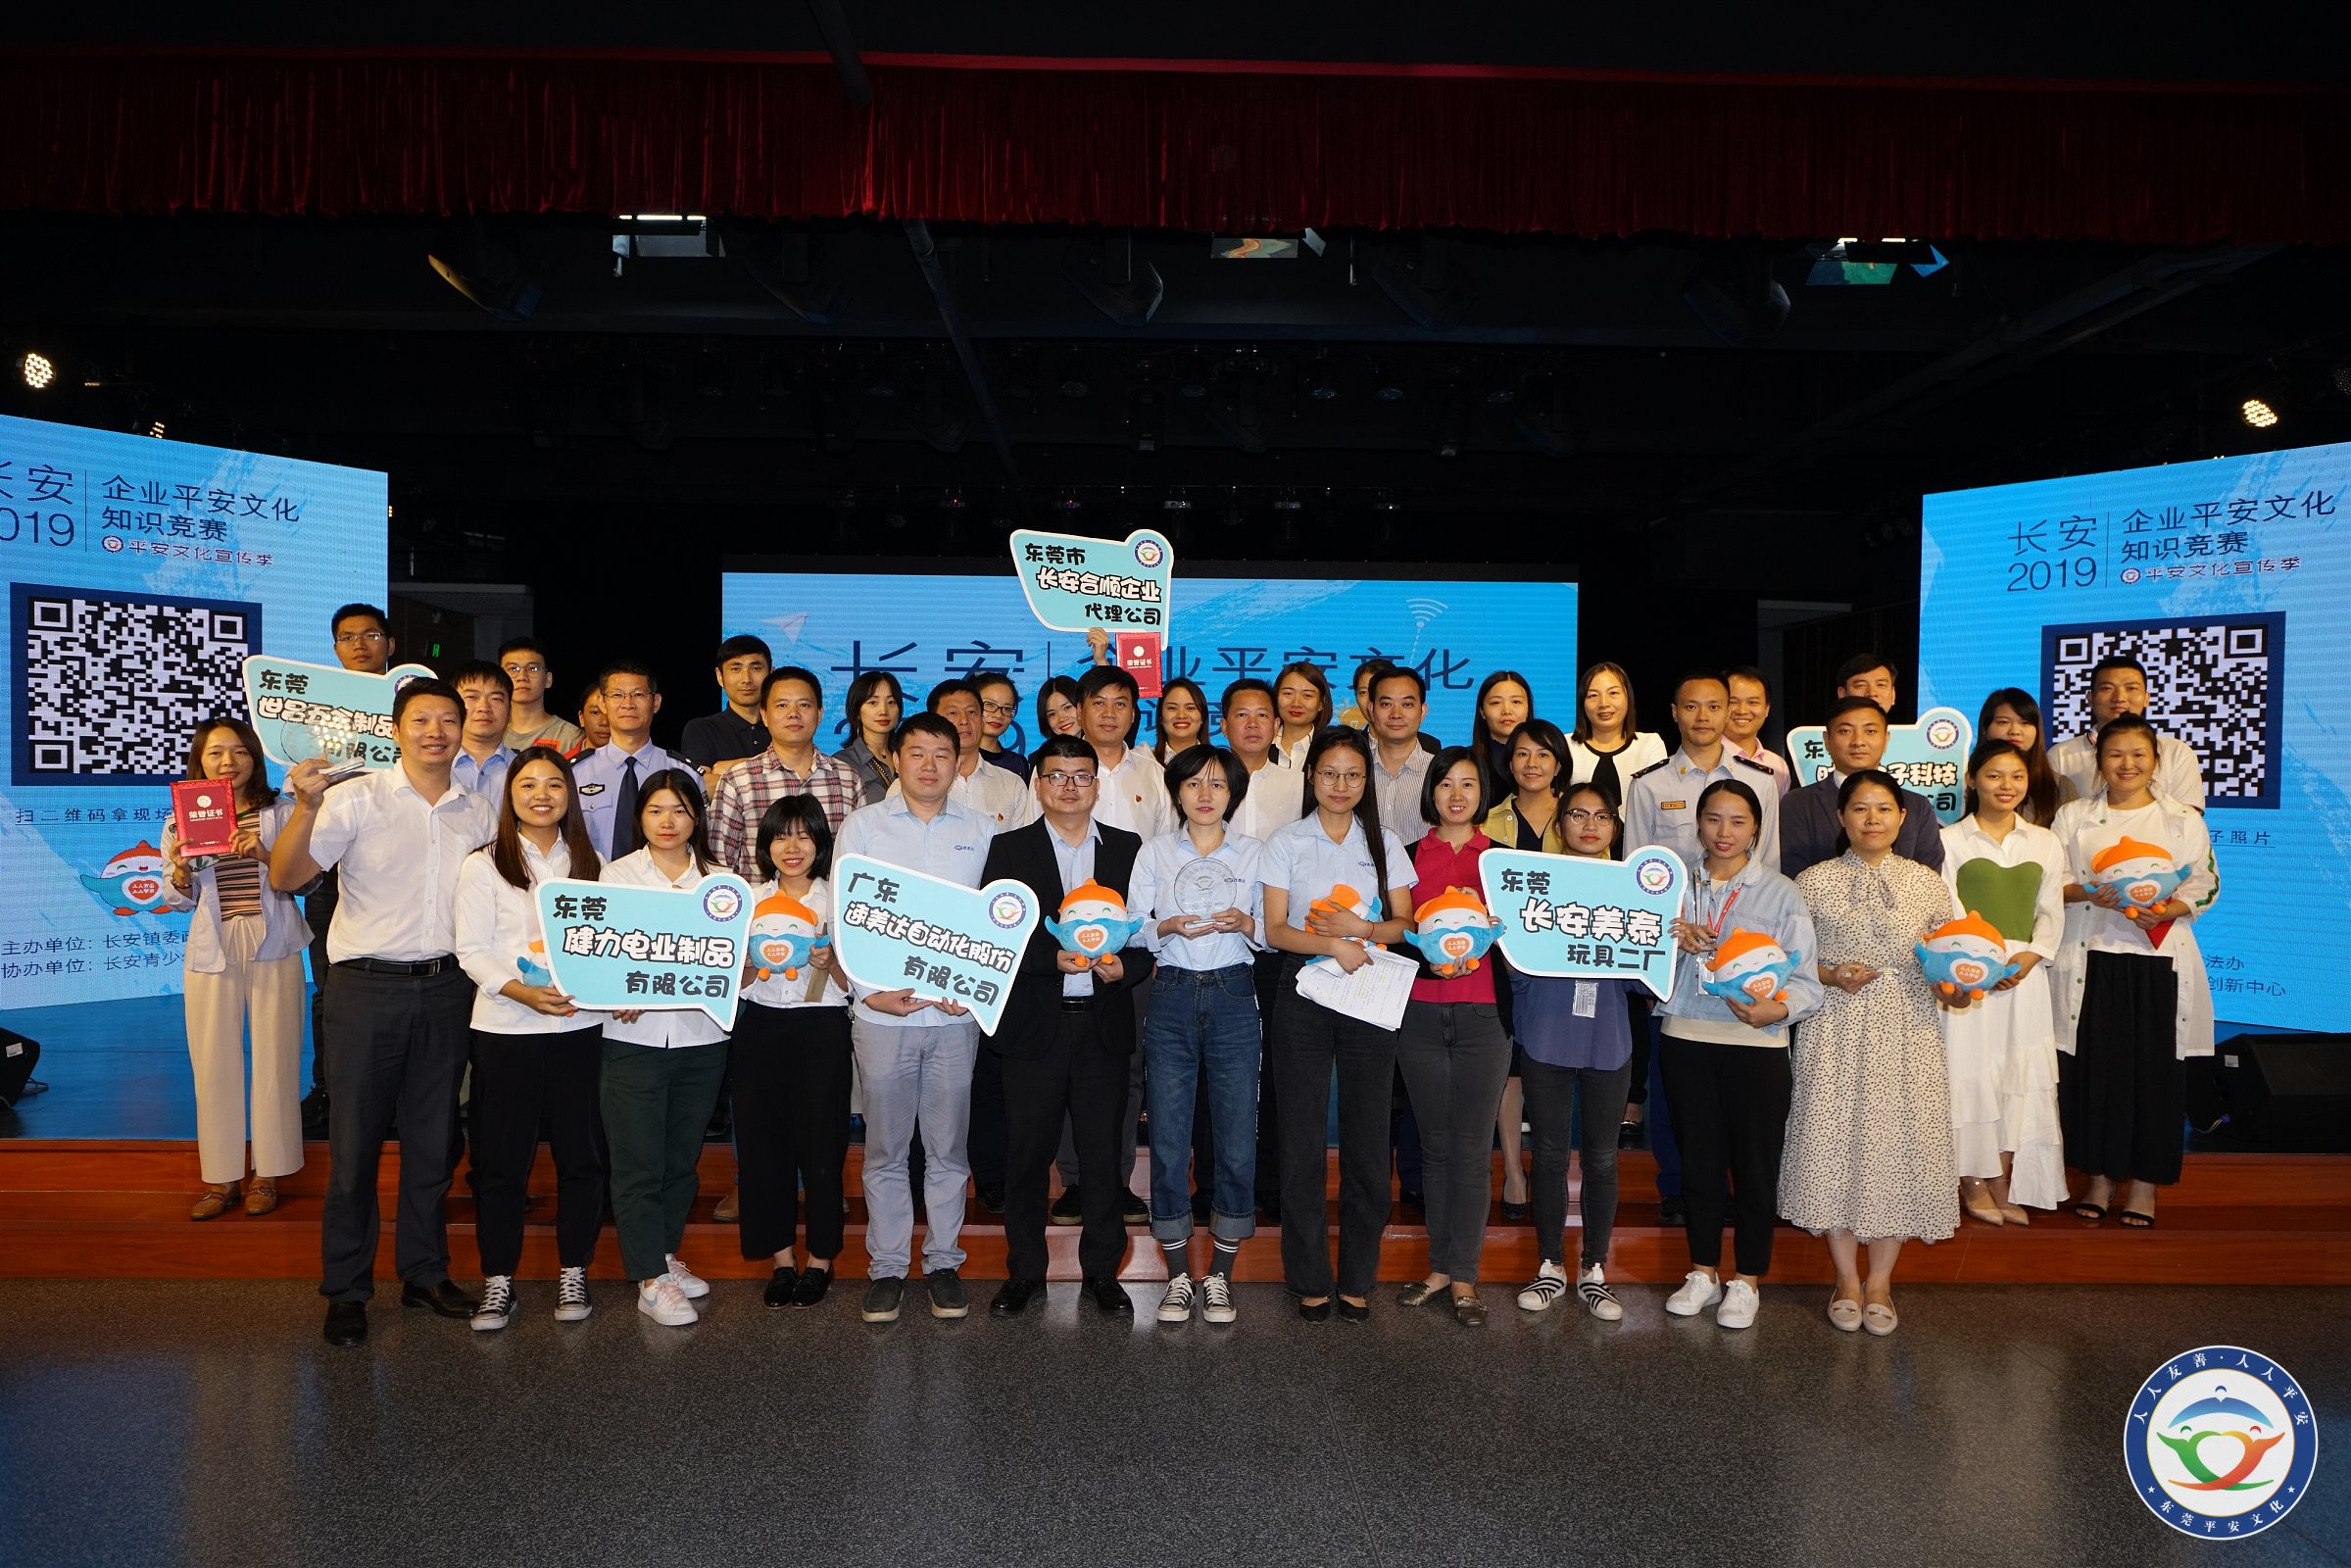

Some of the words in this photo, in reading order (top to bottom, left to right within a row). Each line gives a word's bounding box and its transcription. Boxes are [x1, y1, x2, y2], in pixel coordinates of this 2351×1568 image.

[0, 461, 73, 505] 安
[102, 474, 300, 522] 企业平安文化
[101, 506, 227, 543] 知识竞赛
[2122, 490, 2336, 534] 企业平安文化
[2008, 514, 2097, 556] 长安
[2121, 530, 2249, 564] 知识竞赛
[128, 539, 273, 566] 平安文化宣传季
[1025, 543, 1086, 565] 东莞市
[2145, 556, 2301, 582] 平安文化宣传季
[1036, 565, 1162, 603] 长安合顺企业
[2007, 557, 2097, 592] 2019
[1085, 603, 1161, 626] 代理公司
[259, 669, 309, 695] 东莞
[1077, 643, 1474, 692] 业平安化
[1804, 740, 1832, 760] 东
[16, 808, 173, 823] 扫二维码拿现场
[848, 872, 900, 904] 广东
[1500, 868, 1550, 896] 东莞
[553, 894, 608, 921] 东莞
[1519, 896, 1663, 948] 长安美泰
[563, 924, 735, 968] 健力电业制品
[844, 901, 1016, 974] 速美达自动化股份
[1567, 944, 1666, 971] 玩具二厂
[625, 970, 730, 999] 有限公司
[904, 956, 1000, 1006] 有限公司
[2208, 976, 2286, 997] 创新中心
